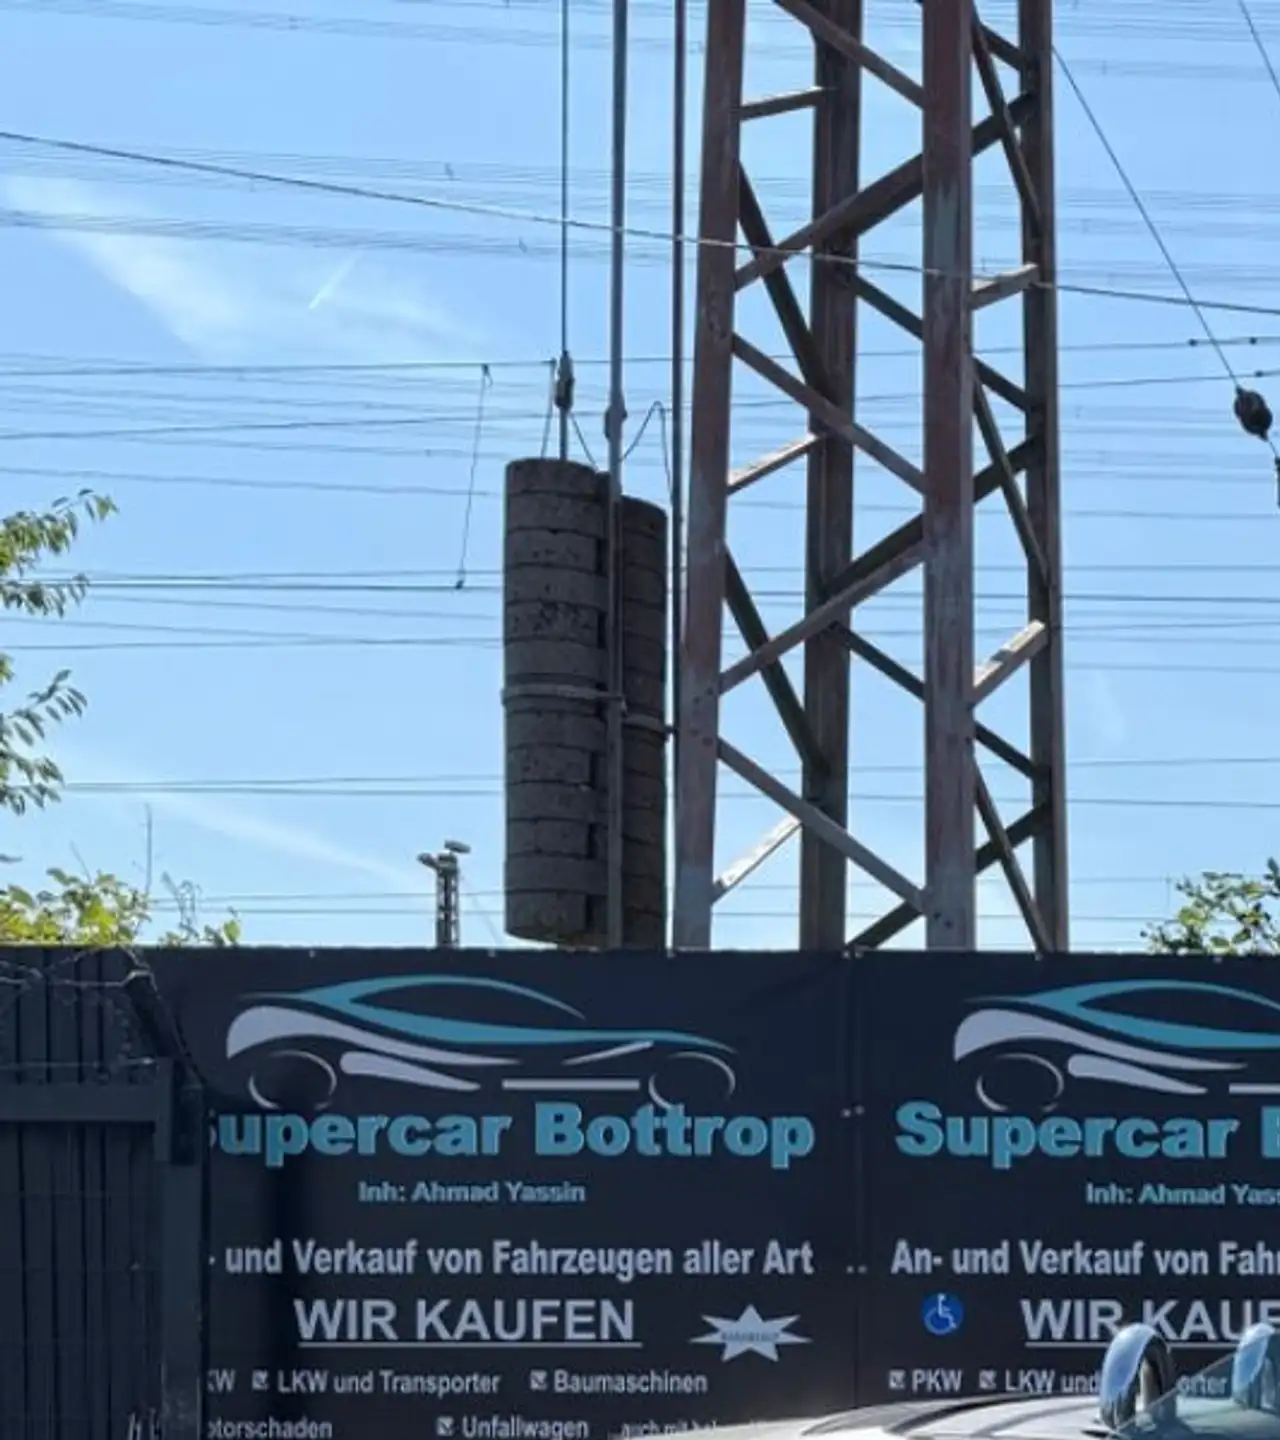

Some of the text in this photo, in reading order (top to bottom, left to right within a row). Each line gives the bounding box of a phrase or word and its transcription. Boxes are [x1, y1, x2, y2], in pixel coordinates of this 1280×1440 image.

[210, 1101, 816, 1169] upercar Bottrop
[895, 1101, 1240, 1168] Supercar
[358, 1181, 586, 1203] Inh: Ahmad Yassin
[1086, 1184, 1134, 1205] Inh:
[1139, 1184, 1226, 1205] Ahmad
[225, 1238, 815, 1284] und Verkauf von Fahrzeugen aller Art
[891, 1241, 943, 1275] An-
[952, 1241, 1010, 1275] und
[1018, 1241, 1144, 1275] Verkauf
[1154, 1249, 1210, 1275] von
[293, 1298, 635, 1341] WIR KAUFEN
[1021, 1299, 1124, 1341] WIR
[277, 1370, 328, 1393] LKW
[333, 1371, 374, 1394] und
[380, 1370, 501, 1398] Transporter
[553, 1370, 709, 1395] Baumaschinen
[912, 1370, 962, 1392] PKW
[1005, 1370, 1055, 1393] LKW
